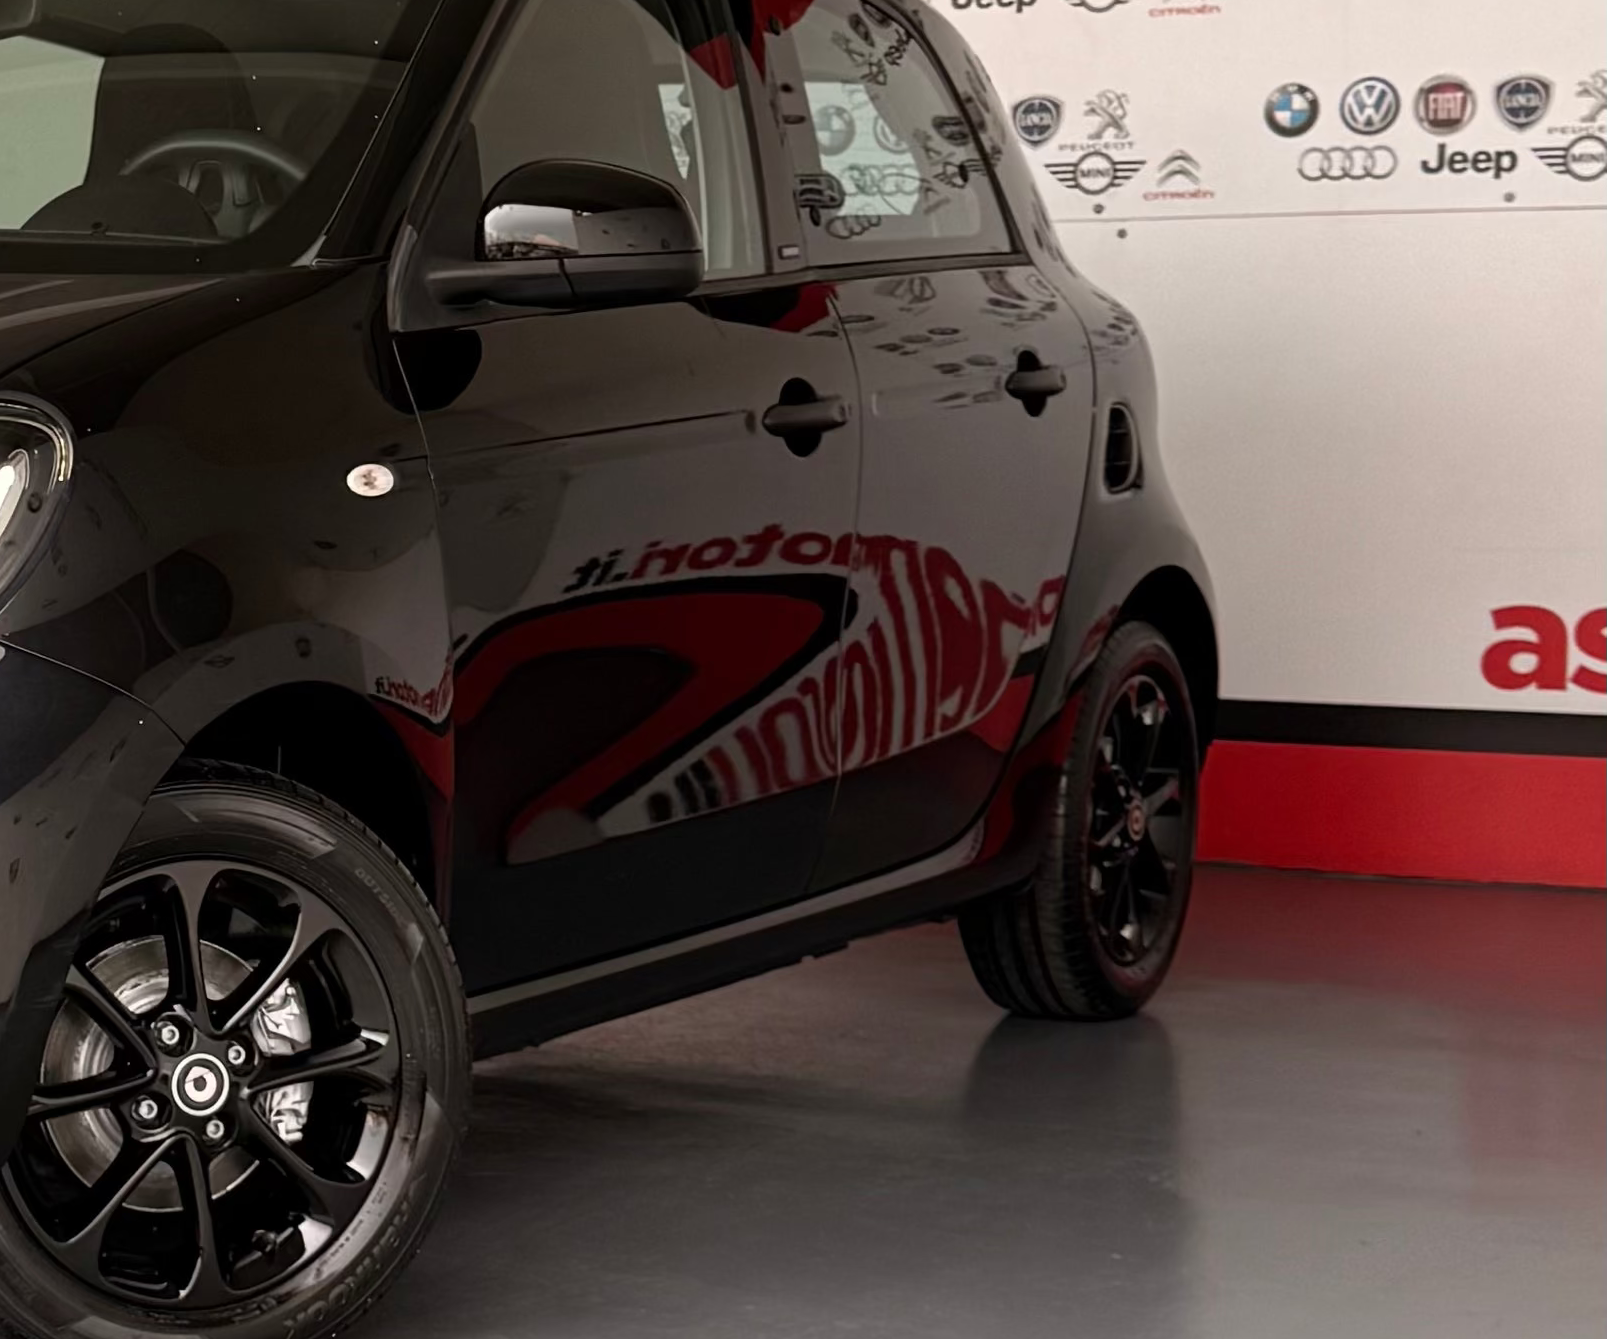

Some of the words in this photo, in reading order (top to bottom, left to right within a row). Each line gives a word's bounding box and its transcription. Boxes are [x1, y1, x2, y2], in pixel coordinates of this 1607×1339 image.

[1428, 92, 1464, 120] FIAT
[1420, 142, 1519, 179] Jeep
[1571, 152, 1605, 164] MINI
[1080, 168, 1112, 179] MINI
